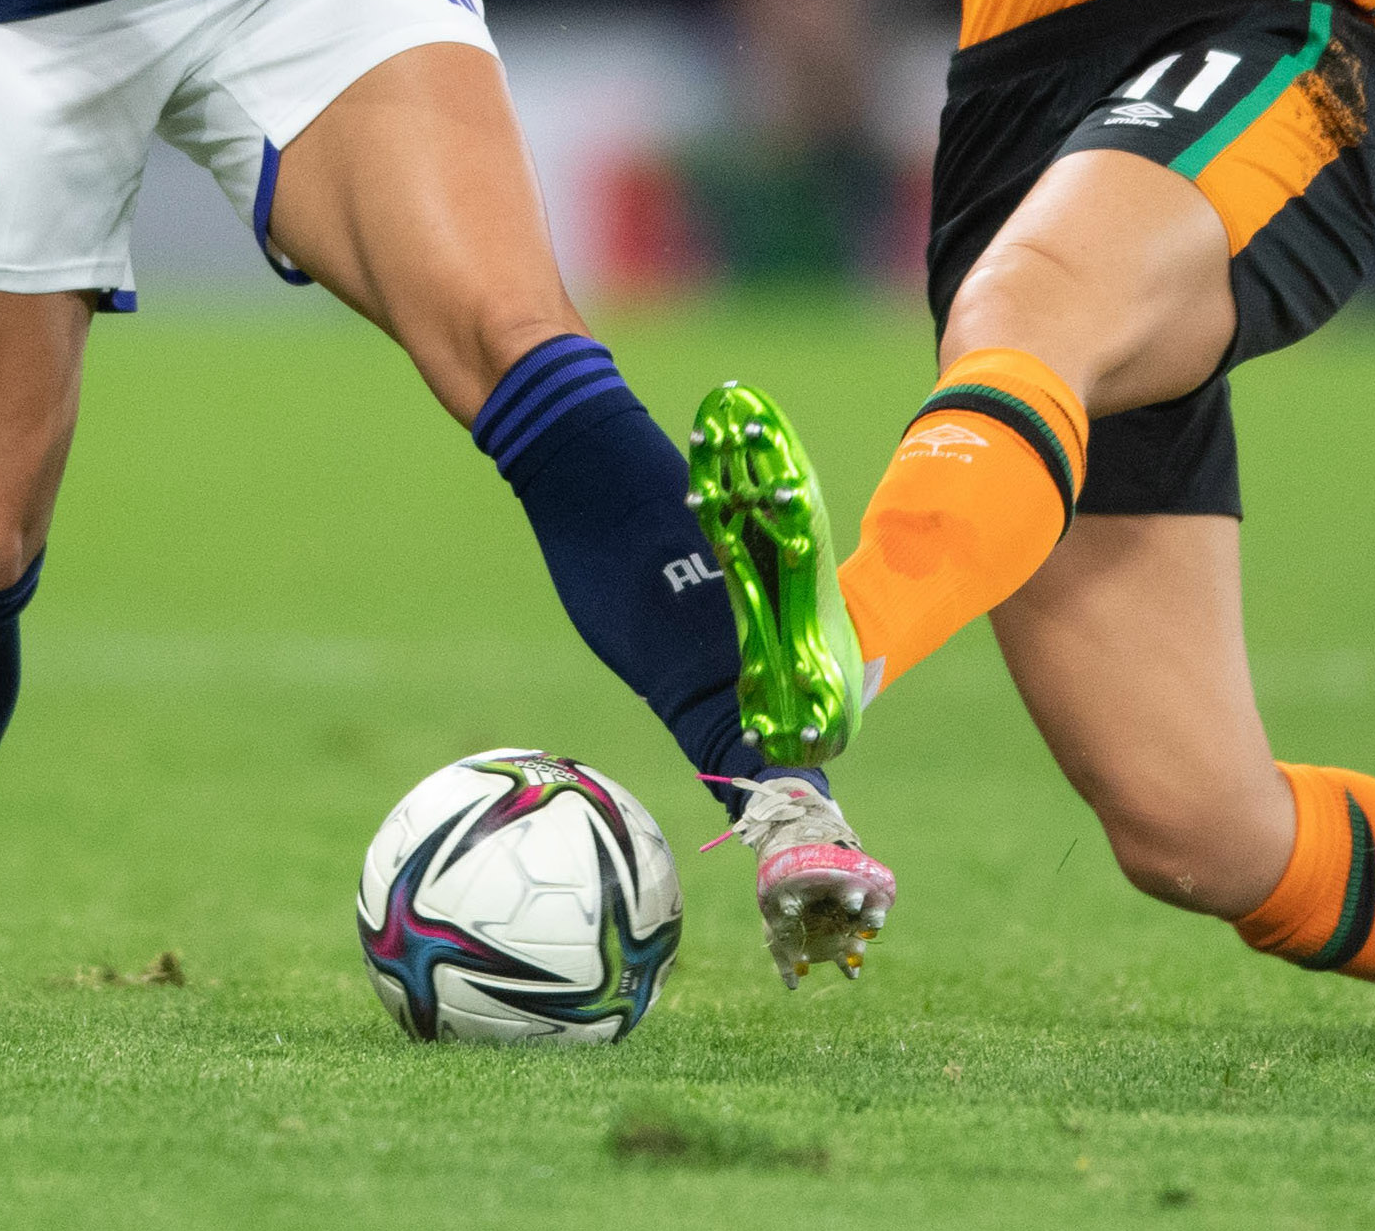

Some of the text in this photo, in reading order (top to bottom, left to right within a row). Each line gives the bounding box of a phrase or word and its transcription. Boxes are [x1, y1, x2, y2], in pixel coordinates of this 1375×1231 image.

[1122, 50, 1242, 112] 11
[1103, 115, 1160, 128] umbro
[663, 552, 724, 593] AL
[513, 760, 579, 781] adidas
